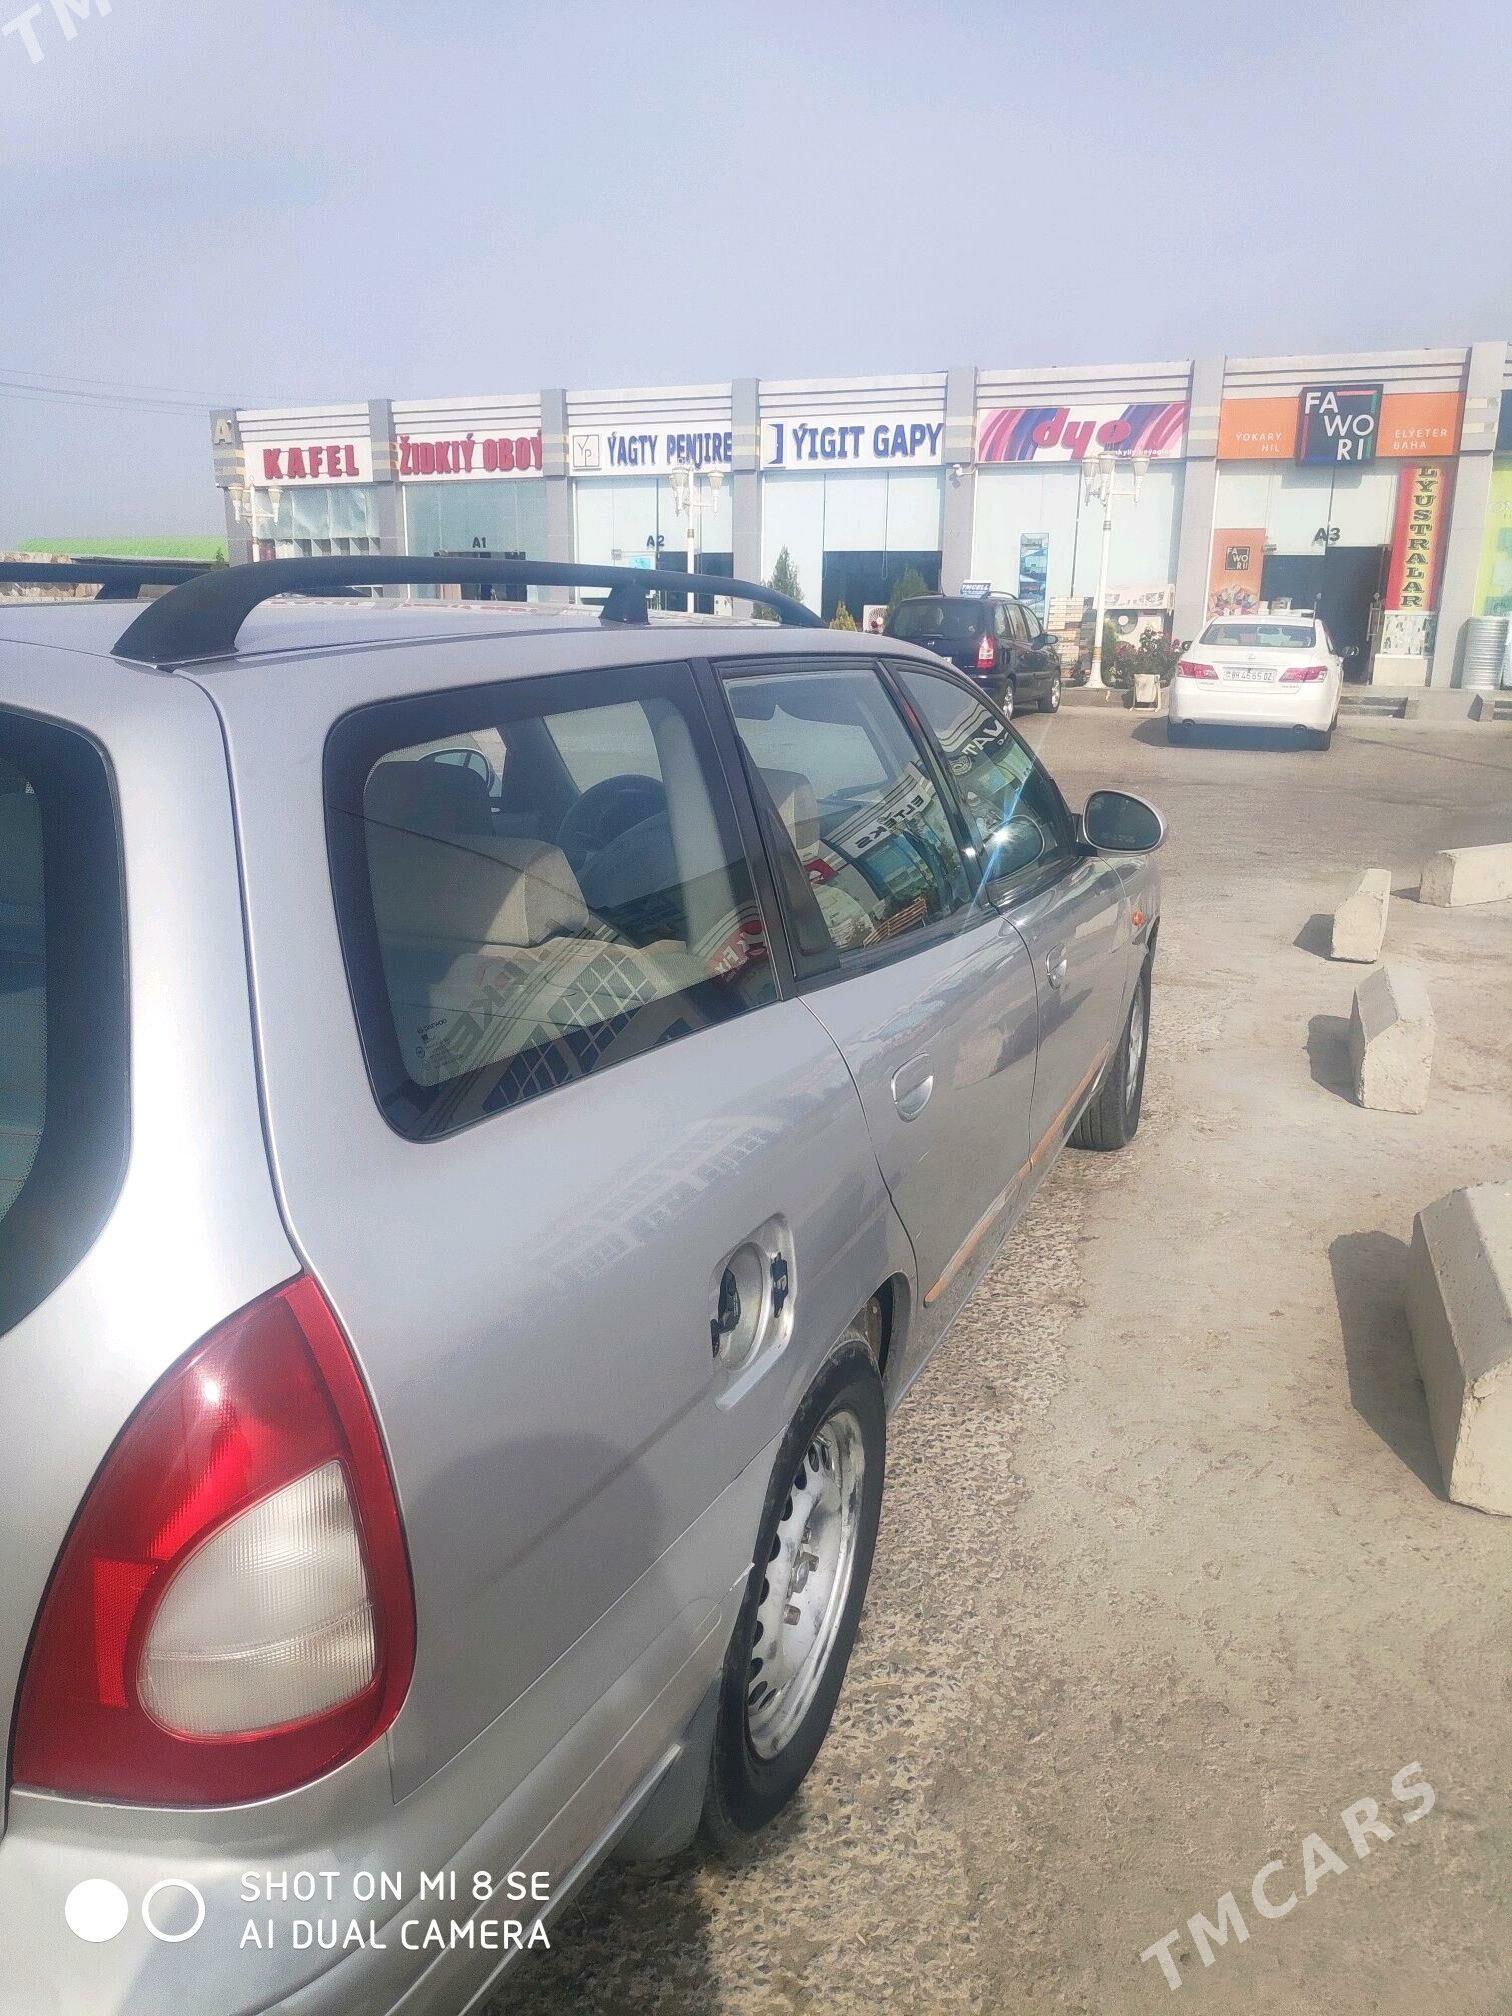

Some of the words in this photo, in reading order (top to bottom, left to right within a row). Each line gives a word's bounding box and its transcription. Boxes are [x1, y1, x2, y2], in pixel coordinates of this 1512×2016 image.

[1305, 391, 1338, 415] FA
[215, 418, 232, 444] A
[1033, 408, 1131, 460] dyo
[1324, 414, 1374, 437] WO
[607, 431, 658, 466] ÝAGTY
[667, 432, 732, 470] PENJIRE
[792, 423, 865, 460] ÝIGIT
[873, 423, 944, 458] GAPY
[1337, 439, 1363, 461] RI
[263, 444, 359, 479] KAFEL
[472, 537, 487, 548] A1
[646, 535, 665, 548] A2
[1314, 527, 1340, 542] A3
[1399, 465, 1438, 607] LYUSTRALAR
